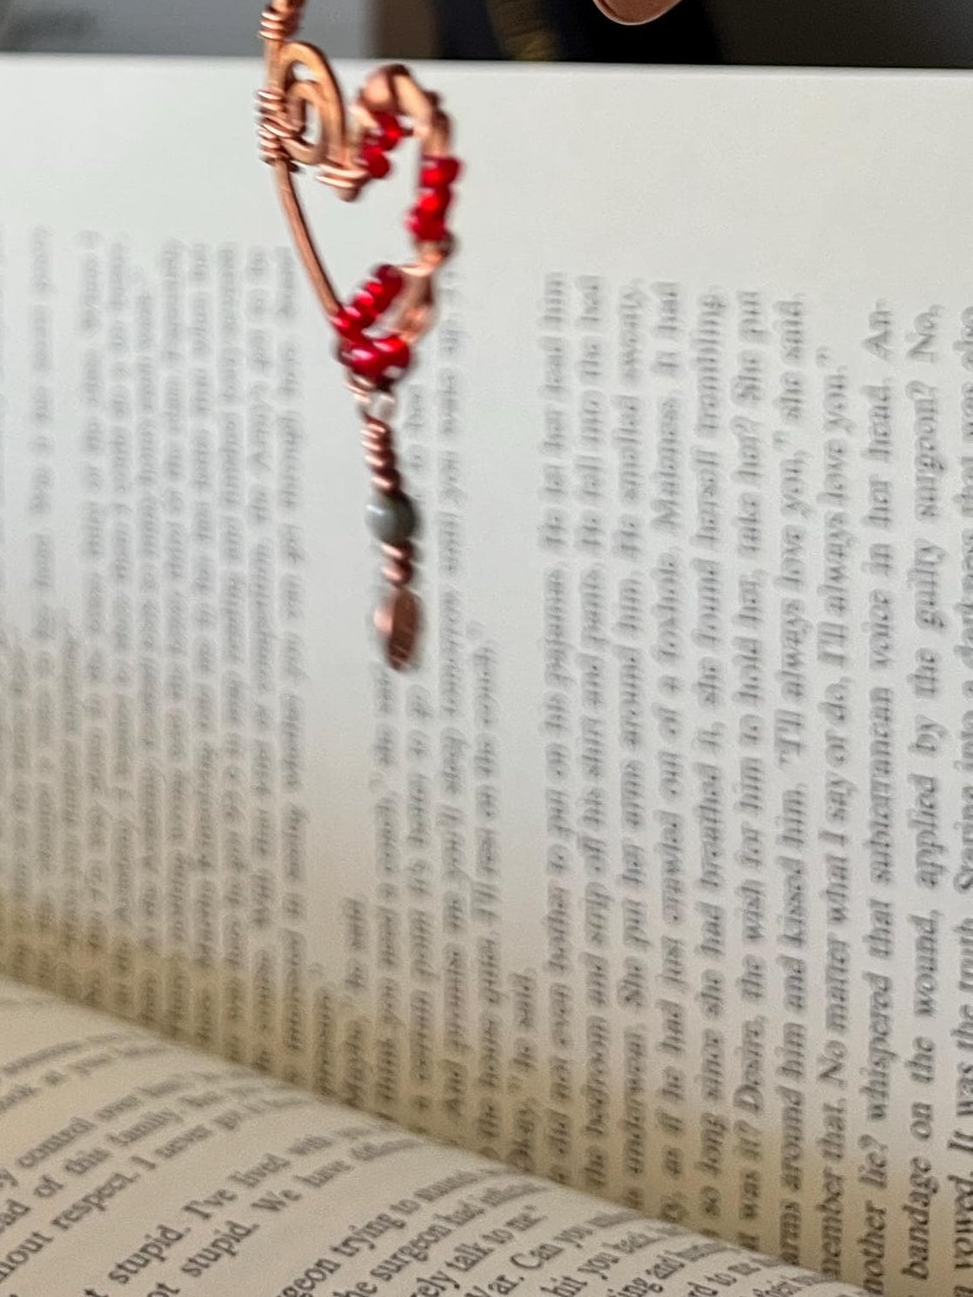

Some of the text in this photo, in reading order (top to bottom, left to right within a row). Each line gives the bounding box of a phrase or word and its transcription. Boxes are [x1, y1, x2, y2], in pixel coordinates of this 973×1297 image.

[860, 298, 893, 363] An-
[772, 371, 804, 426] she
[815, 438, 848, 507] love
[859, 474, 893, 530] her
[773, 524, 805, 593] love
[815, 511, 859, 617] always
[859, 542, 892, 577] in
[774, 598, 813, 706] always
[815, 621, 849, 670] I'll
[859, 589, 894, 670] voice
[816, 676, 855, 727] do,
[823, 729, 849, 769] or
[729, 756, 763, 812] him
[824, 772, 858, 823] say
[861, 687, 894, 885] subterranean
[899, 304, 948, 1280] bandage on the wound, applied by the guilty surgeon? No,
[817, 830, 847, 846] I
[731, 880, 764, 944] wish
[775, 854, 807, 948] kissed
[818, 854, 850, 926] what
[861, 898, 894, 959] that
[733, 953, 764, 1002] the
[775, 954, 806, 1014] and
[823, 934, 850, 1034] matter
[731, 1014, 766, 1115] Desire,
[775, 1022, 805, 1080] him
[815, 1040, 847, 1091] No
[858, 971, 899, 1122] whispered
[952, 1062, 973, 1118] was
[776, 1085, 804, 1192] around
[856, 1134, 889, 1189] lie?
[945, 1130, 973, 1155] It
[33, 1175, 64, 1198] of
[63, 1149, 111, 1176] this
[51, 1173, 139, 1231] respect.
[130, 1156, 157, 1171] I
[739, 1171, 761, 1220] was
[108, 1225, 190, 1284] stupid.
[183, 1190, 237, 1220] I've
[149, 1161, 354, 1296] ot stupid. We have
[282, 1259, 341, 1297] geon
[330, 1205, 406, 1257] trying
[445, 1222, 514, 1272] talk to
[778, 1201, 802, 1266] arms
[814, 1169, 843, 1274] member
[856, 1200, 888, 1295] nother
[333, 1282, 378, 1297] he
[370, 1225, 452, 1282] surgeon
[510, 1244, 564, 1270] Can
